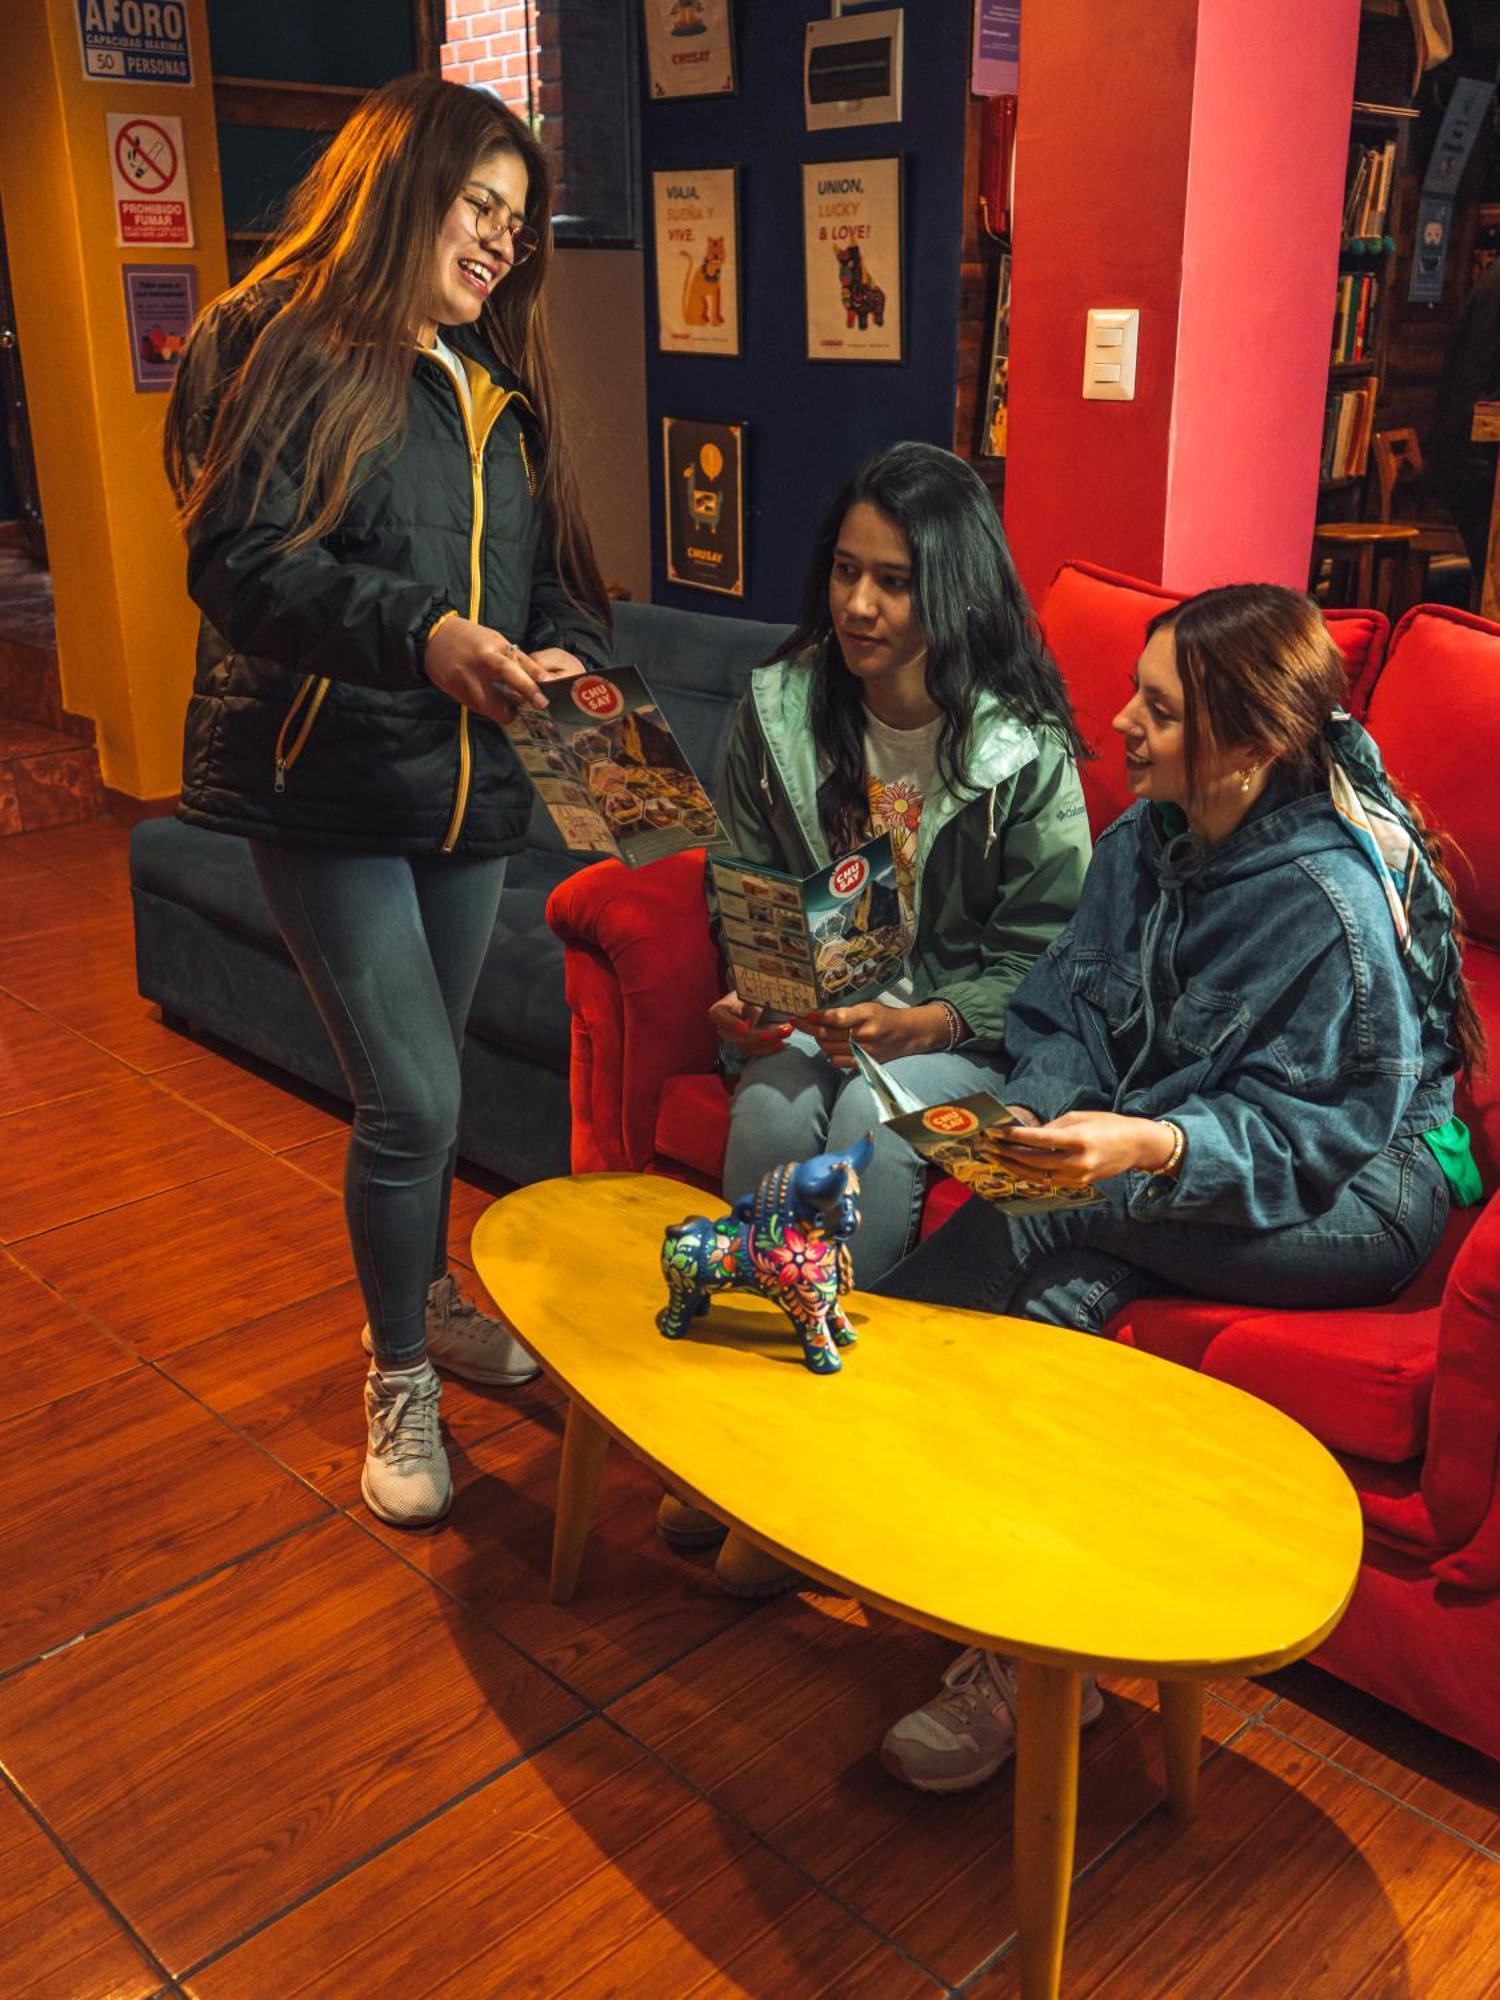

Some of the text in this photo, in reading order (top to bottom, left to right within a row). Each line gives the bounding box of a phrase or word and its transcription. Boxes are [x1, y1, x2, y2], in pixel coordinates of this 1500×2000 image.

[85, 0, 183, 40] AFORO
[96, 53, 115, 69] 50
[127, 56, 188, 76] PERSONAS
[817, 178, 864, 195] UNION,
[122, 203, 182, 215] PROHIBIDO
[707, 207, 715, 219] Y
[818, 202, 860, 218] LUCKY
[134, 215, 172, 226] FUMAR
[819, 224, 872, 241] & LOVE!
[687, 546, 722, 563] CHUSAY
[580, 684, 607, 701] CHU
[588, 693, 611, 710] SAY
[836, 862, 859, 883] CHU
[839, 871, 859, 891] SAY
[932, 1111, 959, 1125] CHU
